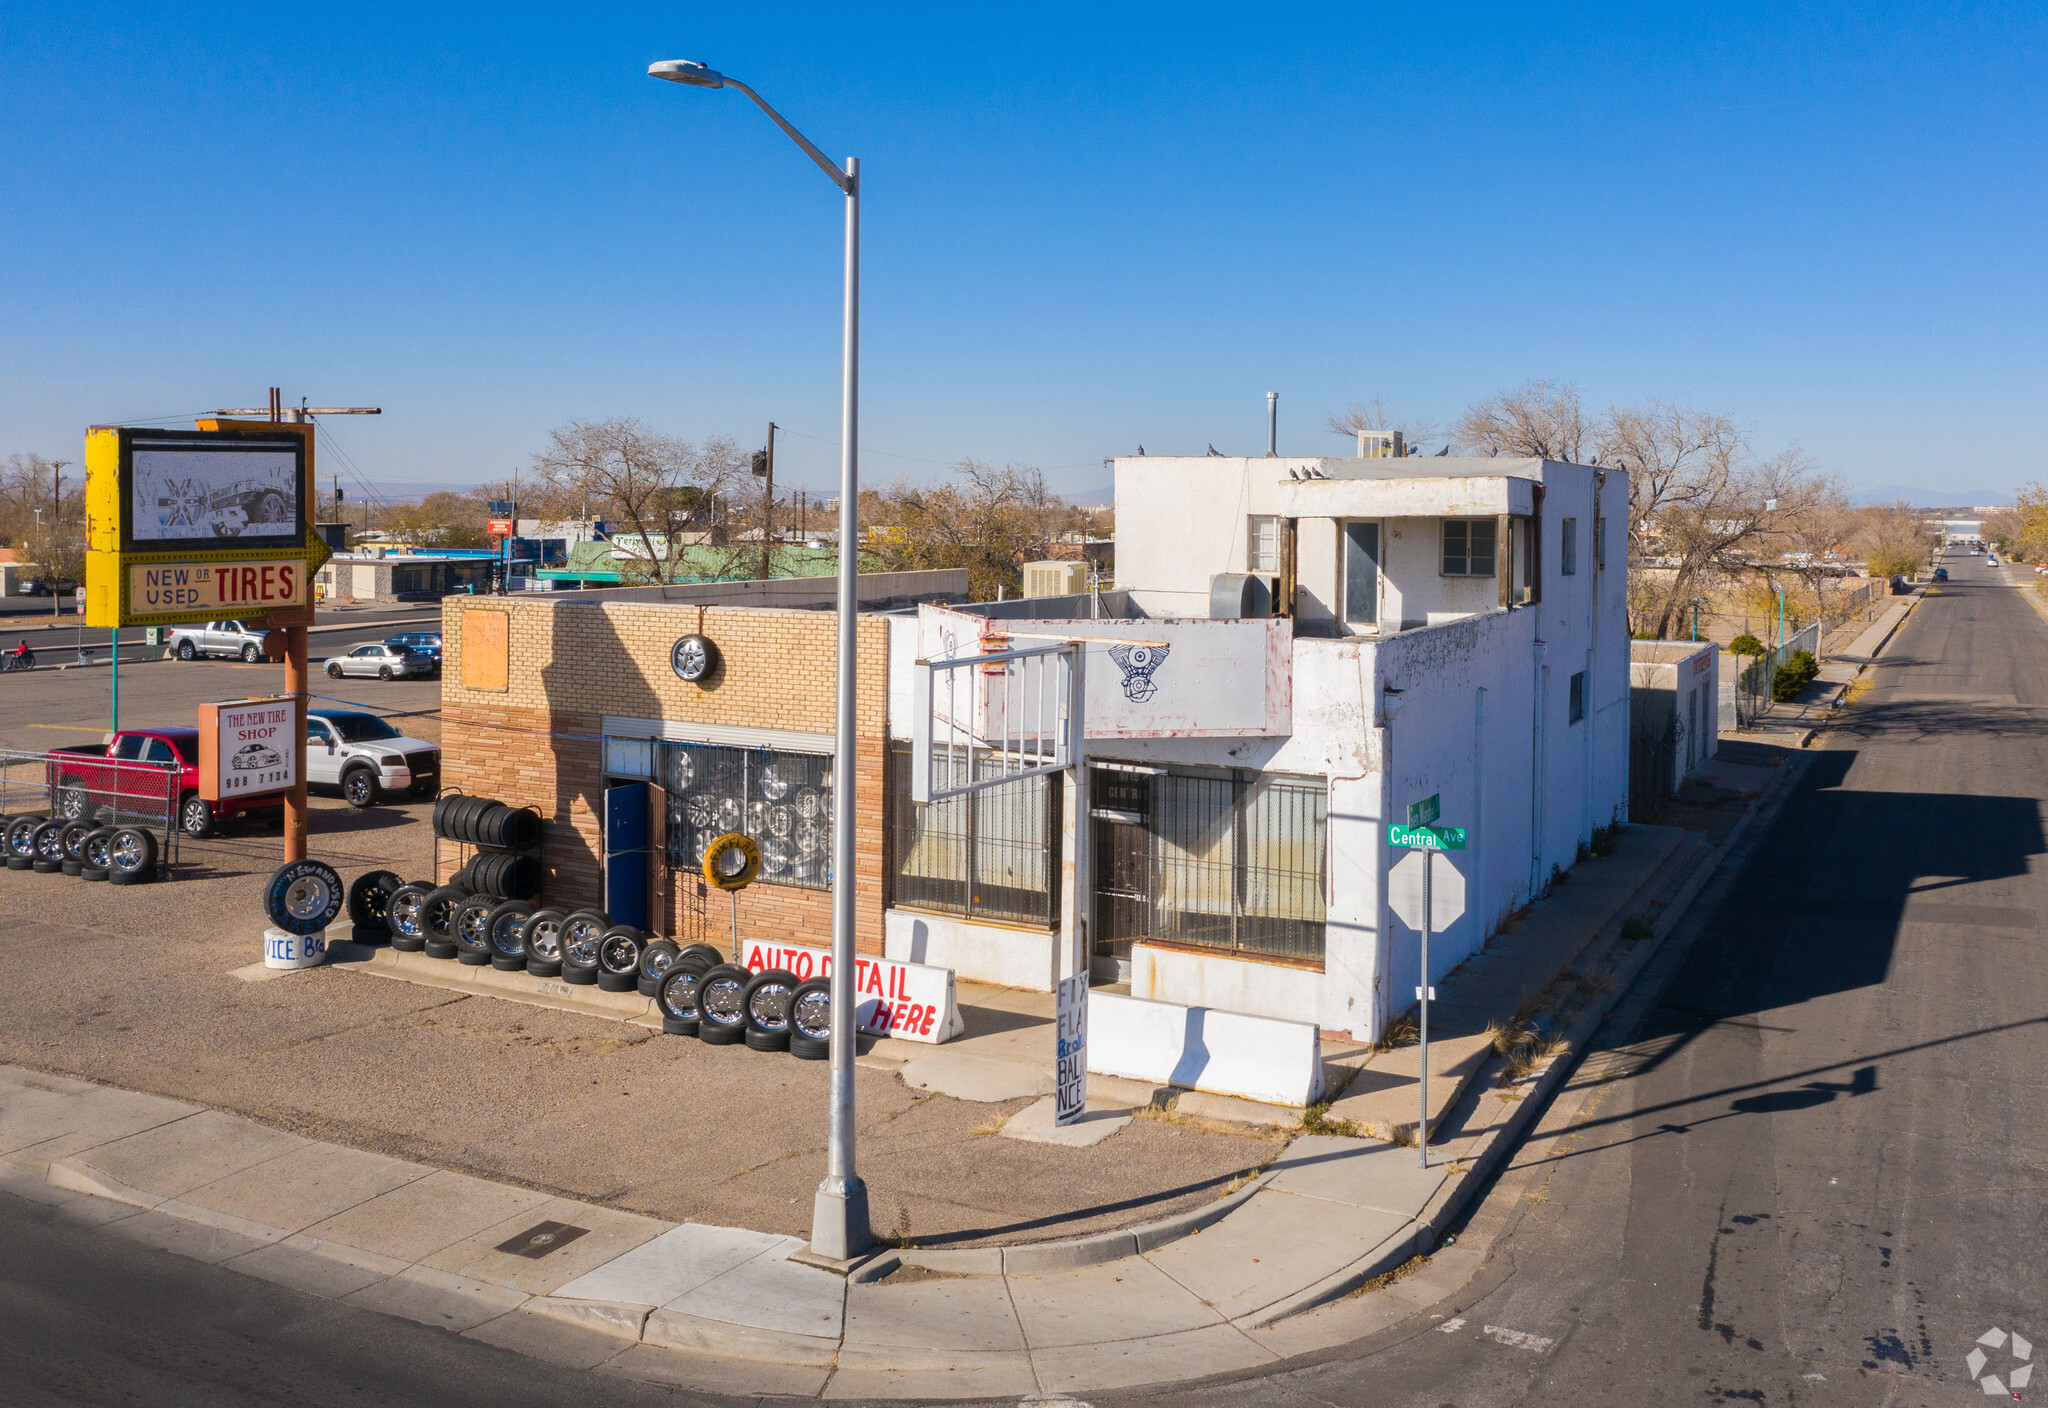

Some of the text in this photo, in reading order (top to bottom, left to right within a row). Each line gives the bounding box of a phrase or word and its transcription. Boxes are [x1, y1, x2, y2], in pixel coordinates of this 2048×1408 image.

[146, 569, 209, 586] NEW OR
[215, 566, 293, 602] TIRES
[147, 589, 199, 605] USED
[227, 709, 286, 728] THE NEW TIRE
[238, 727, 277, 741] SHOP
[226, 770, 288, 789] 908 7134
[1391, 827, 1463, 846] Central Ave
[316, 867, 336, 884] AND
[325, 883, 340, 918] USED
[747, 945, 912, 1002] AUTO TAIL
[1058, 973, 1088, 1008] FIX
[870, 998, 936, 1036] HERE
[1058, 1006, 1087, 1040] FLA
[1057, 1080, 1082, 1112] NCE
